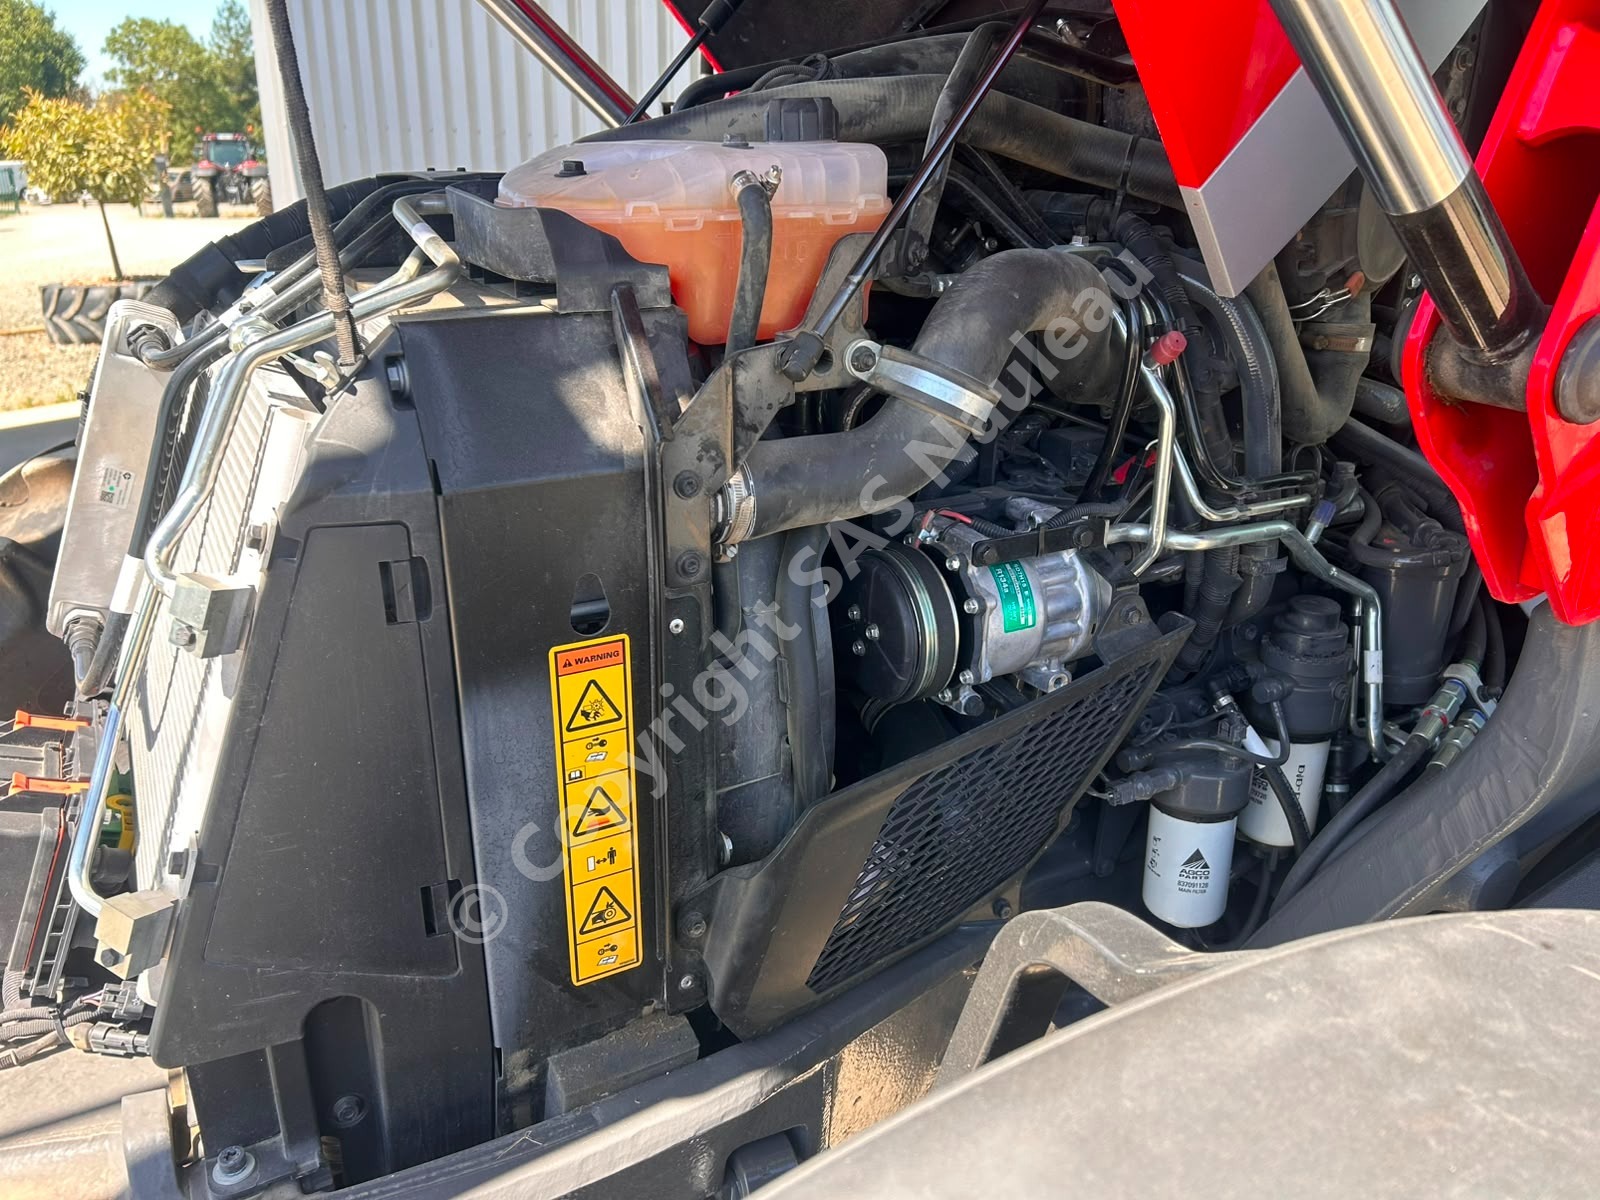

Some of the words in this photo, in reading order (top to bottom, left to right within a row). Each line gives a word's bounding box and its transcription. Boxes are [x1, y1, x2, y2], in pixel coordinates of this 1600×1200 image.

[995, 568, 1009, 593] R134a
[574, 650, 620, 665] WARNING
[1179, 868, 1210, 876] AGCO
